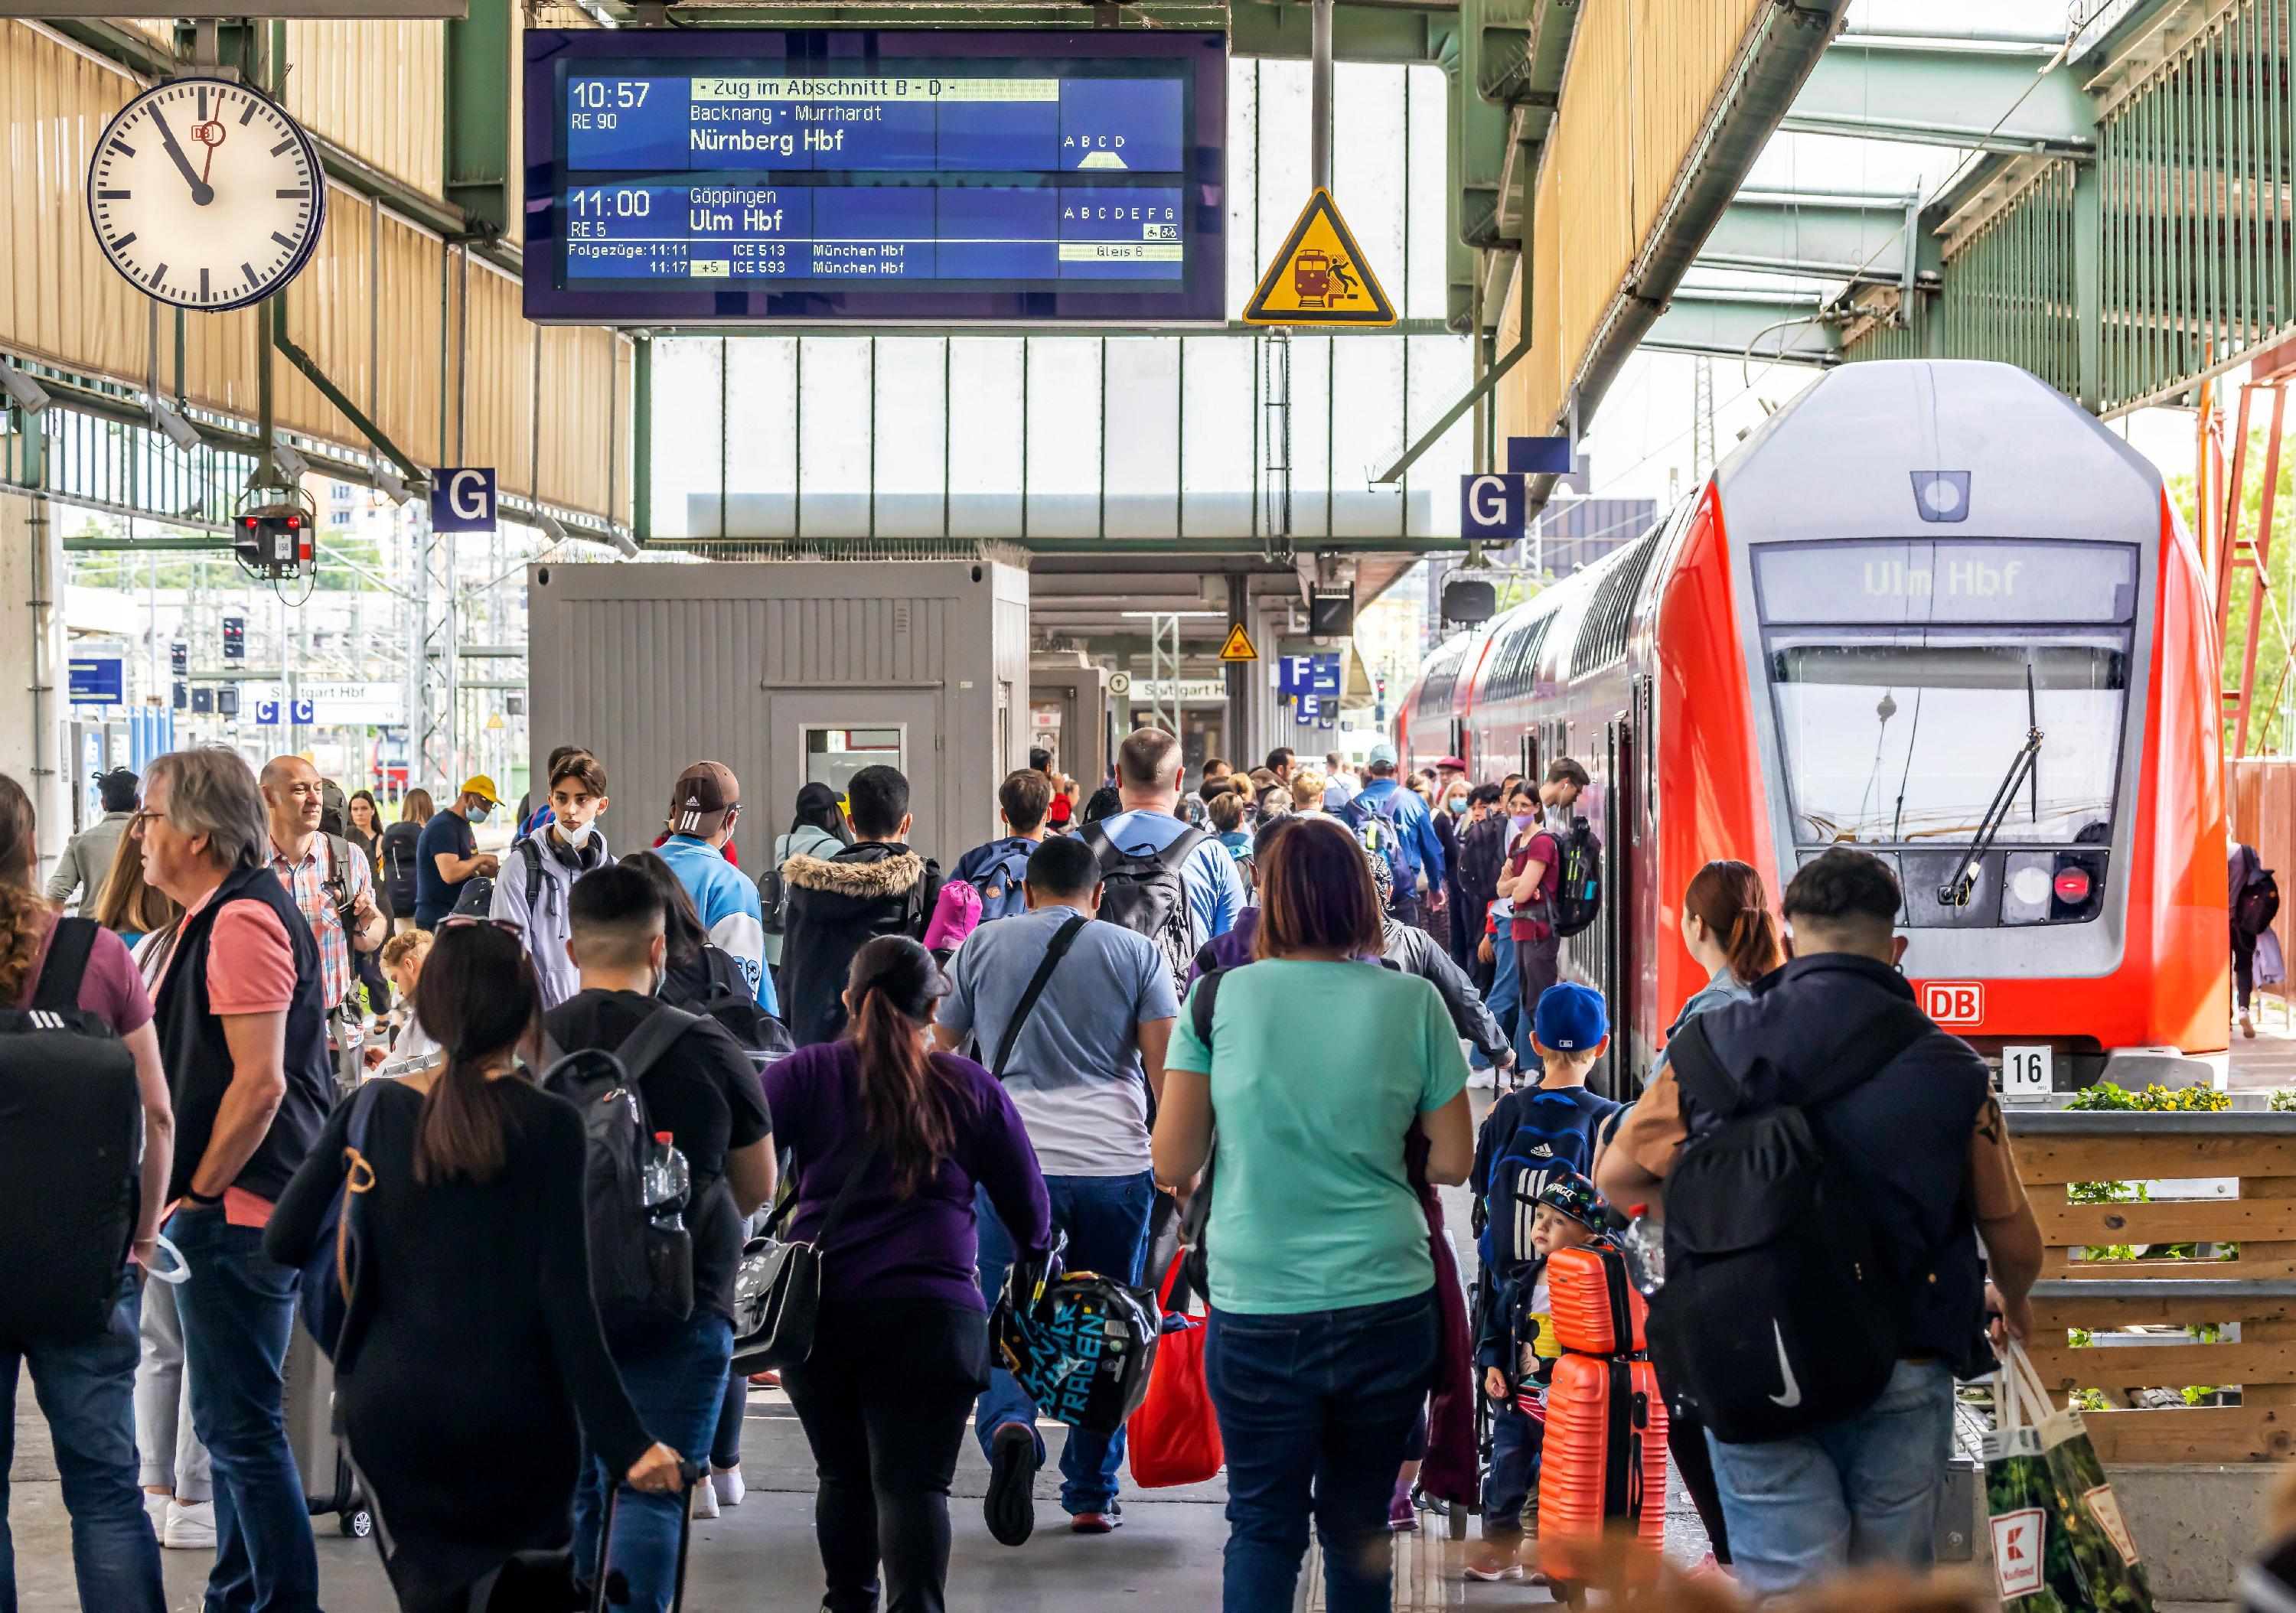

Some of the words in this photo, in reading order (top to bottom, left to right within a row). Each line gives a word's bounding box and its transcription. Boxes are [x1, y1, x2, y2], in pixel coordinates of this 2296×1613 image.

[573, 83, 649, 108] 10:57
[714, 80, 749, 99] Zug
[758, 80, 778, 95] im
[787, 80, 888, 95] Abschnitt
[930, 80, 941, 95] D
[572, 113, 591, 129] RE
[598, 113, 617, 129] 90
[690, 106, 771, 124] Backnang
[795, 106, 882, 121] Murrhardt
[690, 129, 793, 156] Nürnberg
[804, 129, 844, 151] Hbf
[1065, 136, 1075, 147] A
[1081, 136, 1090, 147] B
[1099, 136, 1107, 147] C
[1116, 136, 1124, 147] D
[572, 190, 649, 217] 11:00
[690, 188, 776, 207] Göppingen
[690, 210, 732, 231] Ulm
[744, 210, 783, 231] Hbf
[1065, 207, 1074, 219] A
[1081, 207, 1090, 219] B
[1099, 208, 1107, 219] C
[1116, 208, 1124, 219] D
[1132, 208, 1139, 219] E
[1149, 208, 1156, 219] F
[1166, 208, 1173, 219] G
[571, 222, 590, 236] RE
[597, 222, 606, 236] 5
[569, 244, 647, 258] Folgezüge:
[651, 244, 687, 256] 11:11
[733, 245, 754, 256] ICE
[758, 245, 785, 256] 513
[813, 245, 876, 256] München
[882, 245, 904, 256] Hbf
[1097, 246, 1130, 256] Gleis
[651, 261, 687, 272] 11:17
[702, 262, 718, 272] +5
[733, 262, 754, 273] ICE
[758, 262, 785, 273] 593
[813, 262, 876, 273] München
[882, 262, 904, 273] Hbf
[450, 470, 487, 520] G
[1469, 477, 1507, 526] G
[1865, 561, 1932, 595] Ulm
[1950, 561, 2023, 595] Hbf
[1293, 658, 1310, 686] F
[341, 686, 364, 697] Hbf
[258, 701, 272, 720] C
[296, 699, 311, 720] C
[1304, 694, 1318, 713] E
[1931, 991, 1975, 1018] DB
[2014, 1054, 2041, 1083] 16
[2007, 1527, 2024, 1561] K
